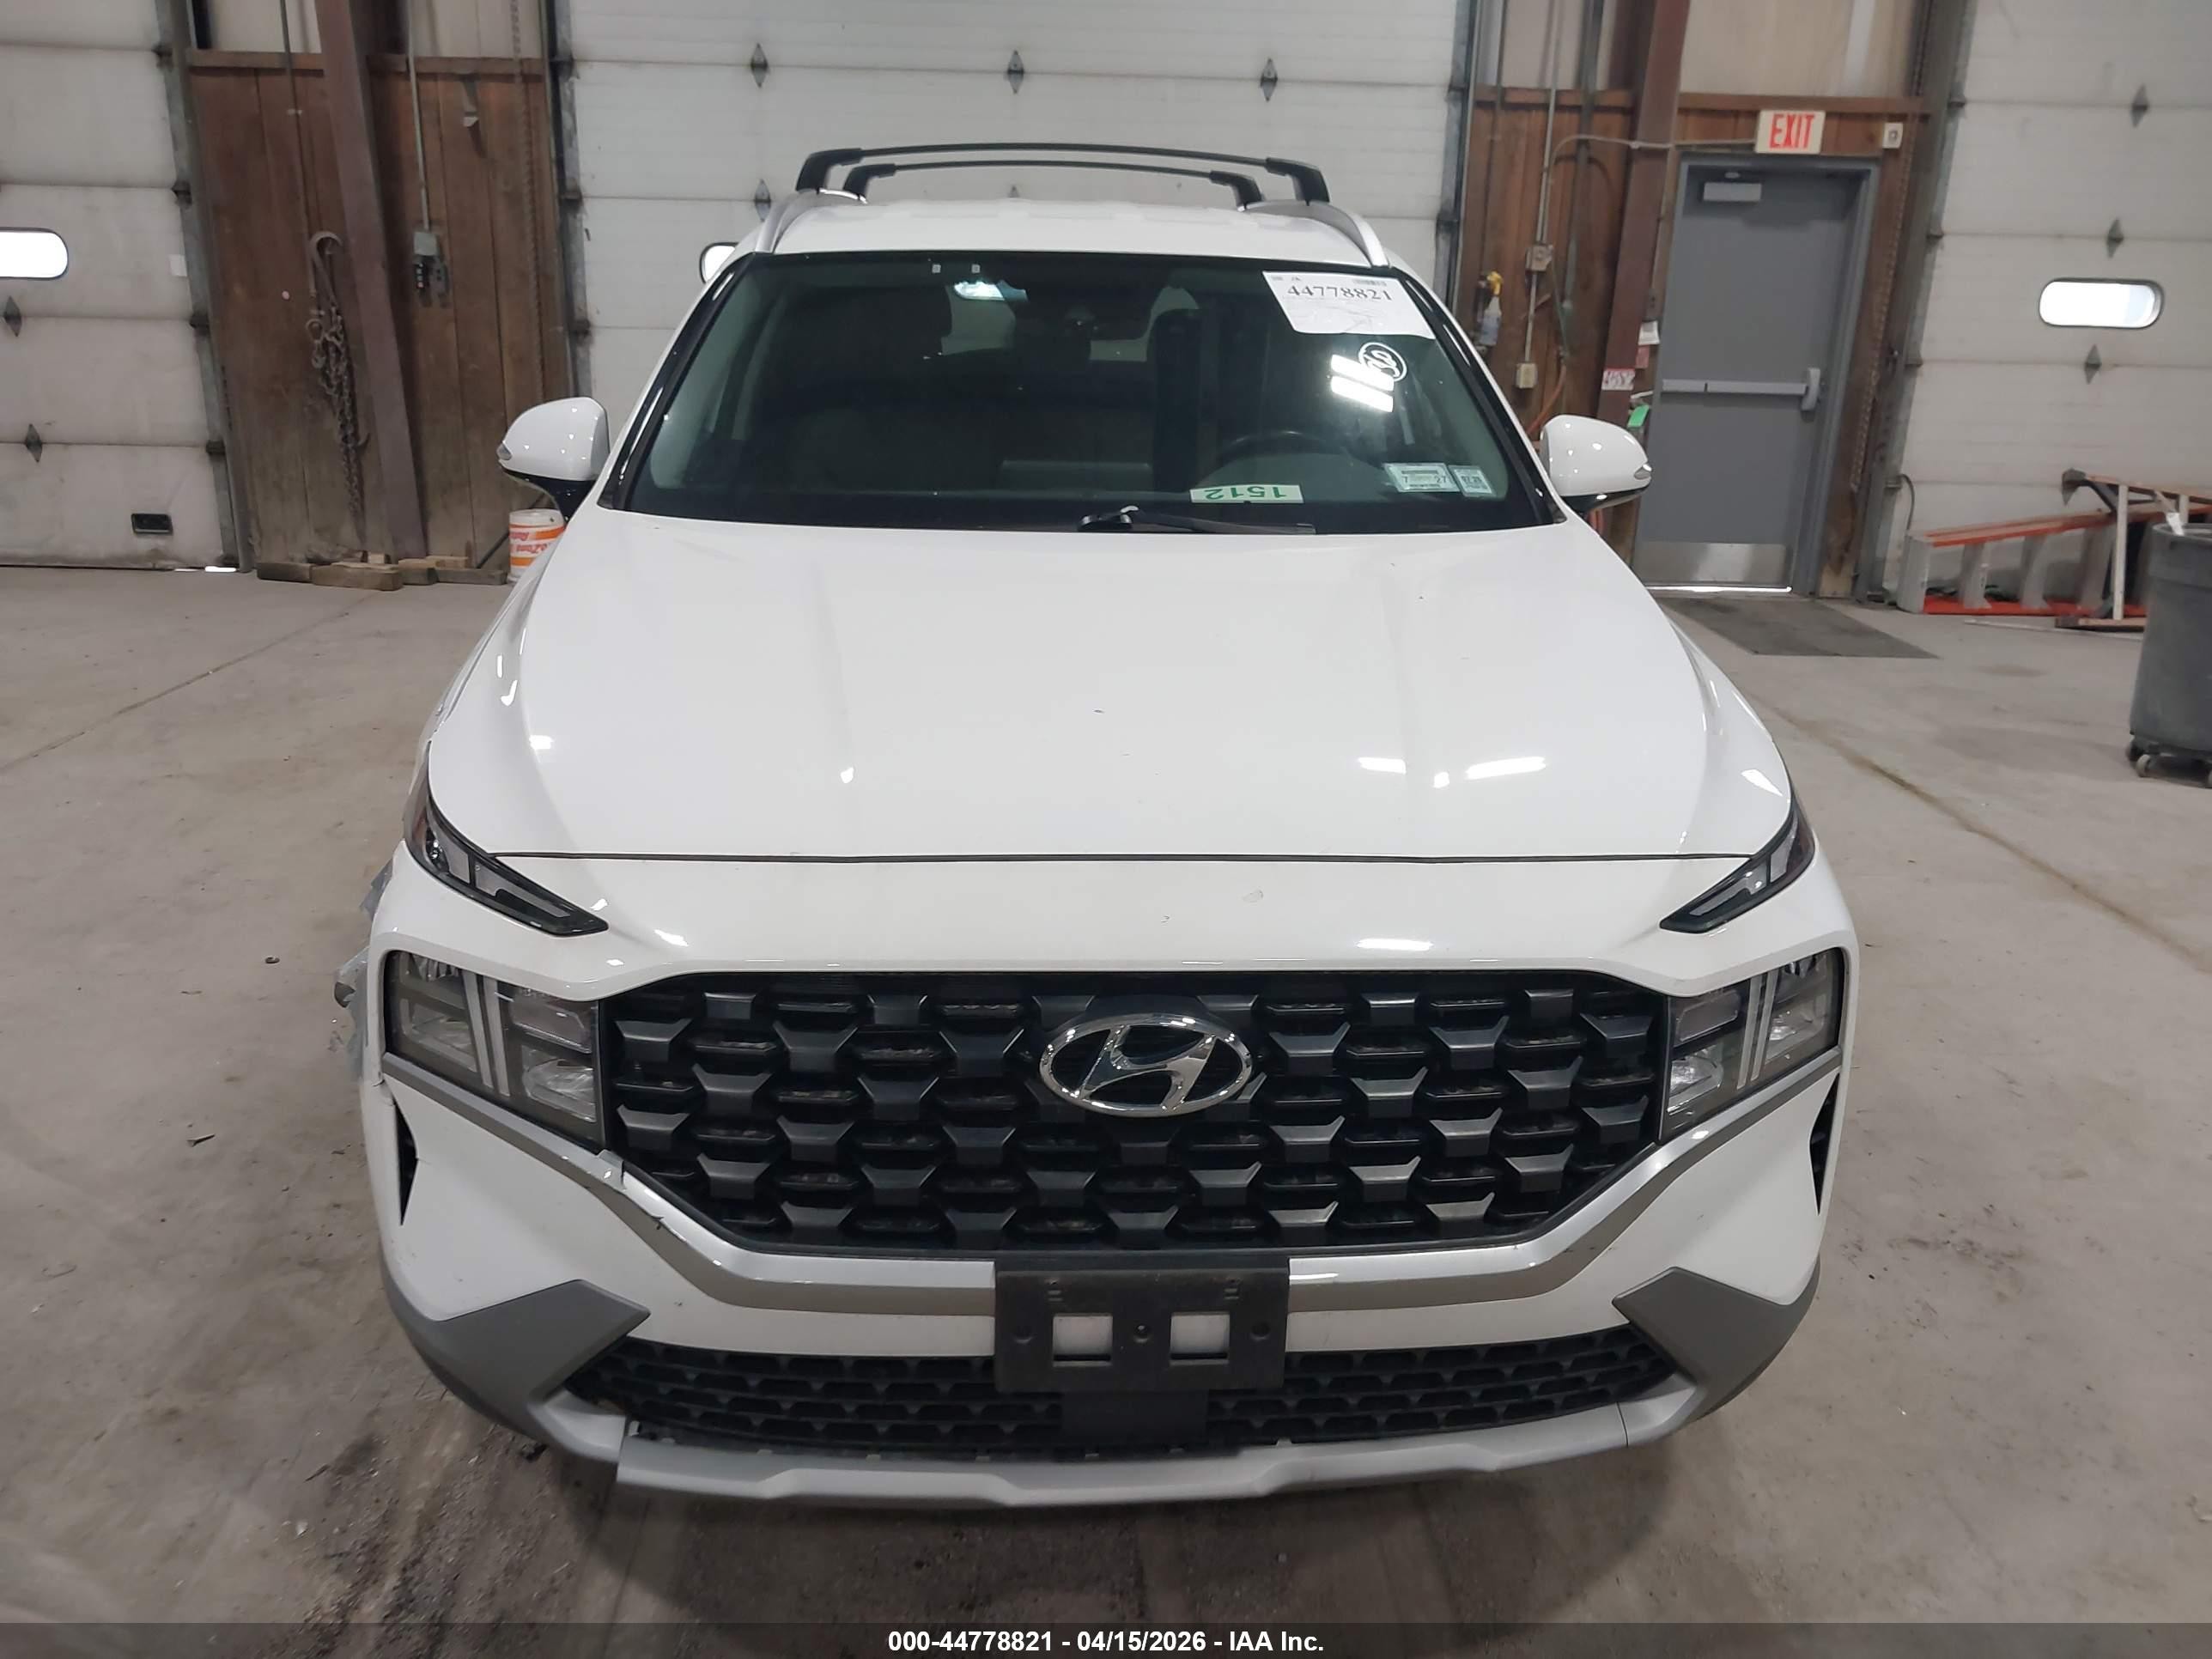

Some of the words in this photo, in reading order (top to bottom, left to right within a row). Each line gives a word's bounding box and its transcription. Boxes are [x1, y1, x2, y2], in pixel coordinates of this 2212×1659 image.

[1769, 113, 1815, 149] EXIT
[1287, 285, 1393, 301] 44778821
[1204, 486, 1288, 500] 1512
